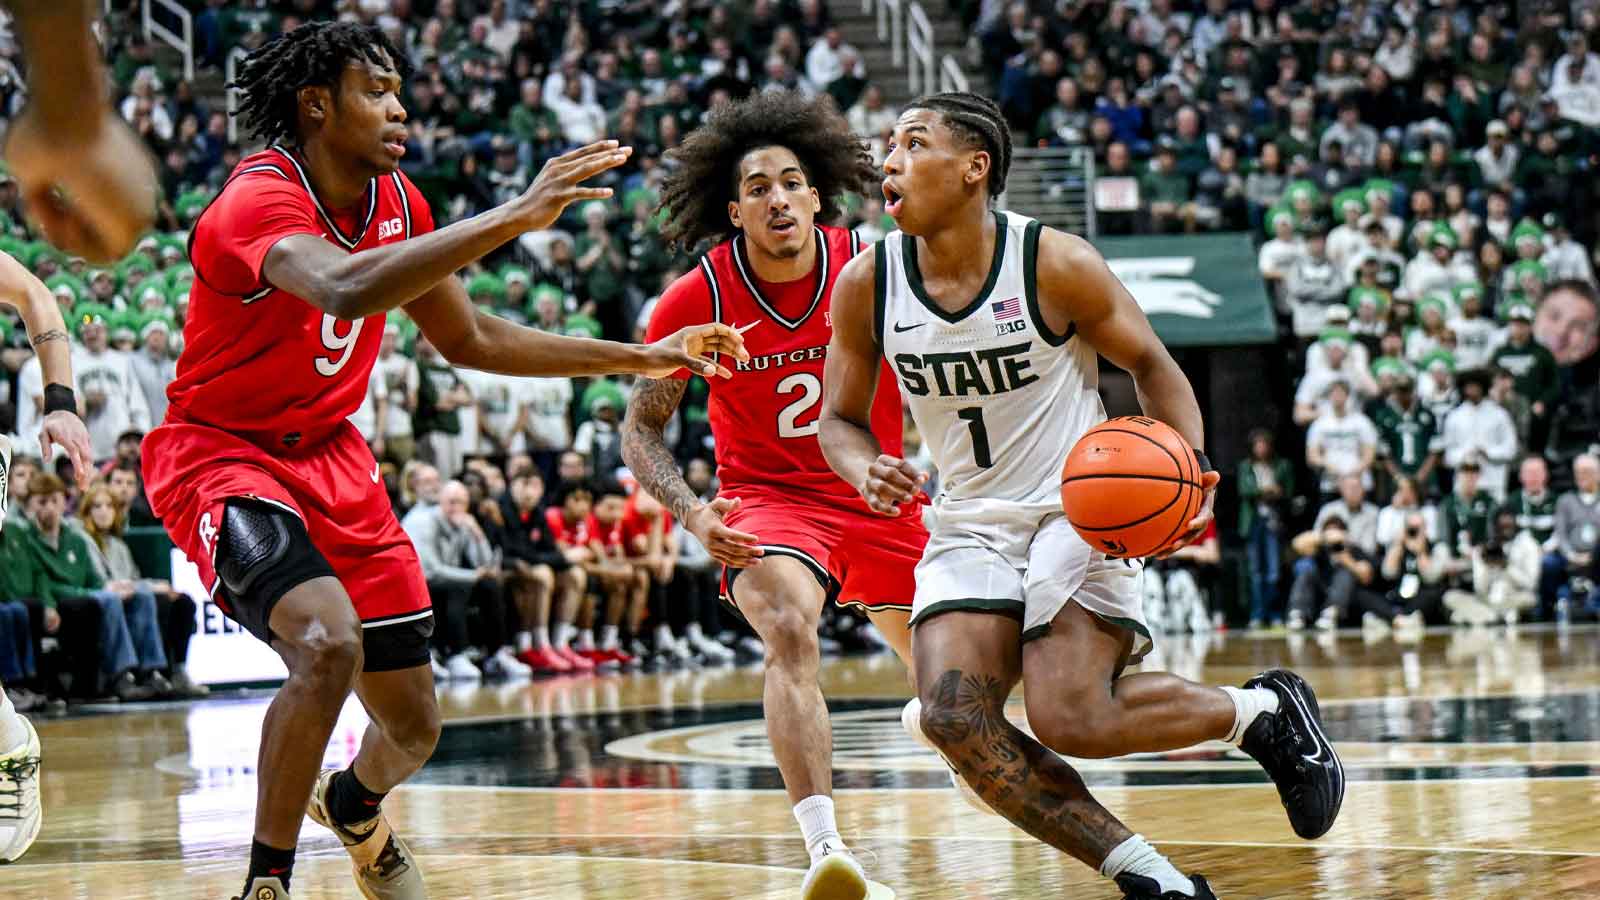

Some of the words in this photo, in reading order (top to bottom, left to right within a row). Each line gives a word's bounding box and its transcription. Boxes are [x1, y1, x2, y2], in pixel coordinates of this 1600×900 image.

[314, 311, 365, 377] 9
[736, 344, 832, 371] RUTGE
[894, 341, 1040, 397] STATE
[776, 372, 822, 438] 2
[957, 406, 994, 469] 1
